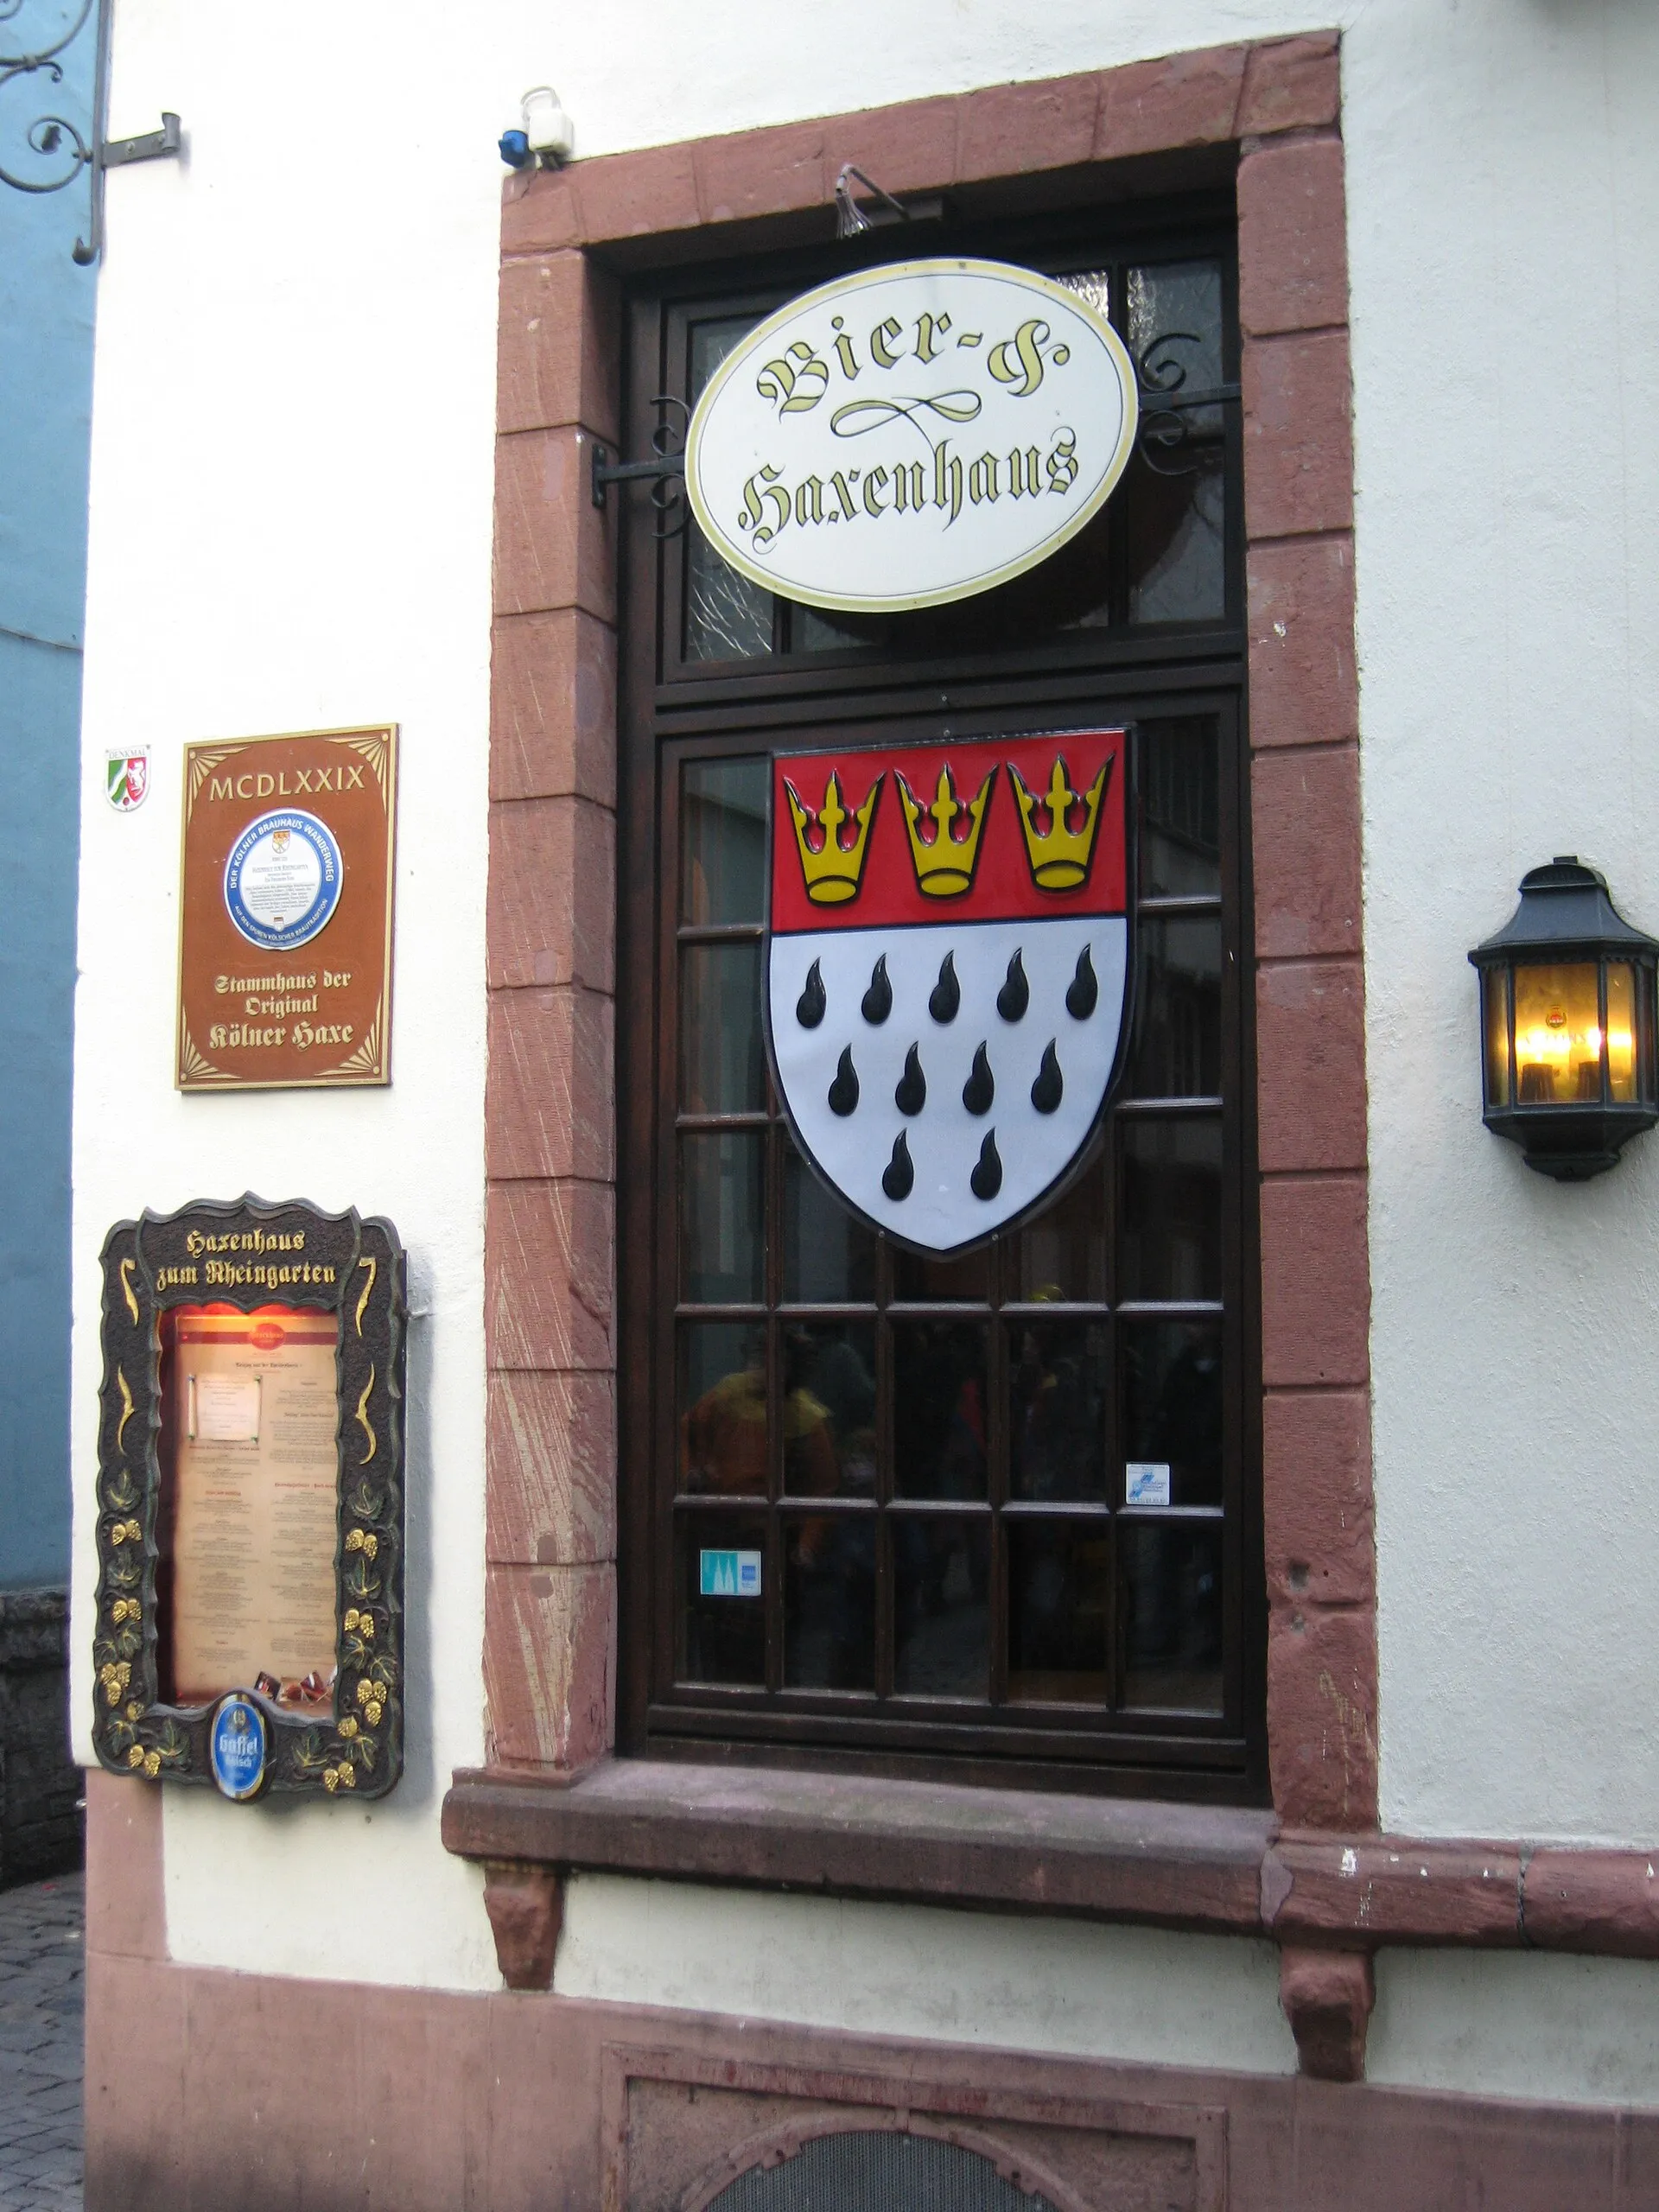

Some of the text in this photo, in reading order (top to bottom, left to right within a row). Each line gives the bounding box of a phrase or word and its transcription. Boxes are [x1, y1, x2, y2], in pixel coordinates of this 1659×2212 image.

[757, 312, 983, 423] Bier-
[737, 426, 1079, 555] Haxenhaus
[109, 747, 145, 760] DENKMAL
[209, 765, 367, 802] MCDLXXIX
[230, 818, 334, 889] DER KÖLNER BRAUHAUS WANDERWEG
[214, 969, 353, 995] Stammhaus der
[245, 995, 319, 1019] Original
[209, 1022, 354, 1052] Kölner Haxe
[186, 1229, 306, 1259] Haxenhaus
[156, 1259, 336, 1292] zum Rheingarten
[219, 1734, 258, 1756] Gaffel
